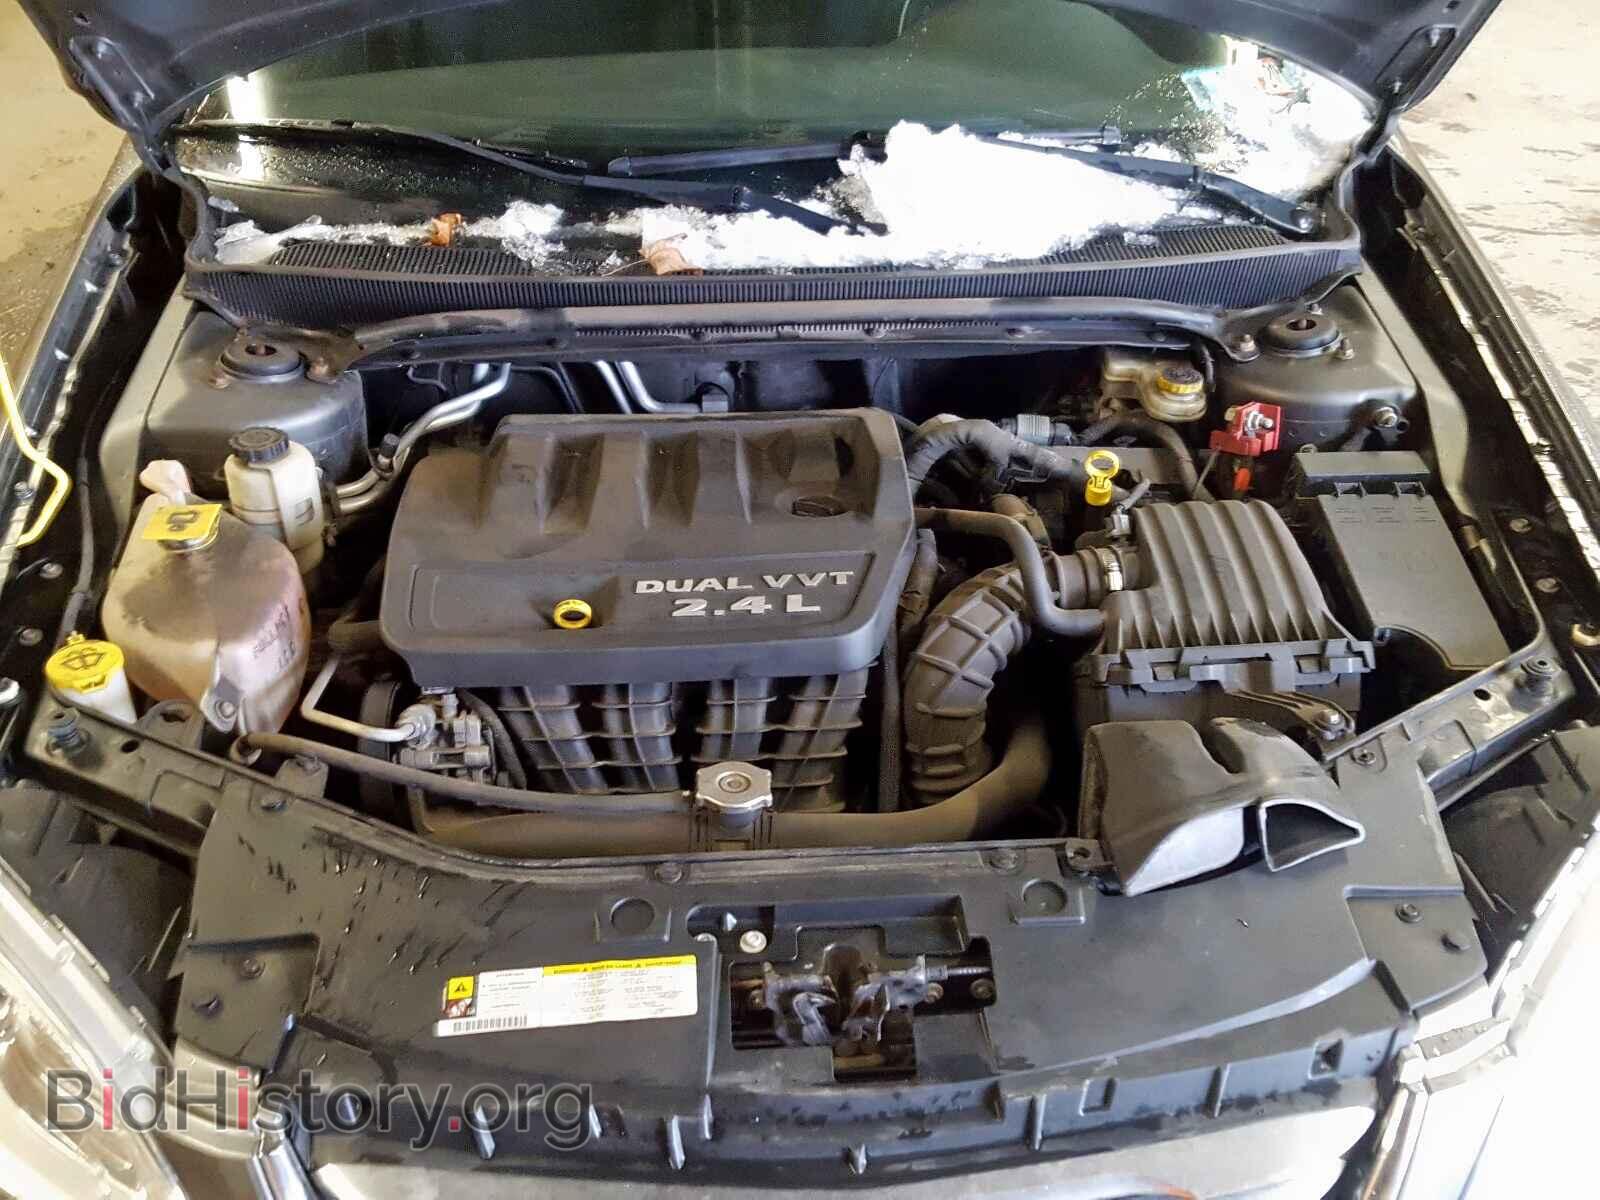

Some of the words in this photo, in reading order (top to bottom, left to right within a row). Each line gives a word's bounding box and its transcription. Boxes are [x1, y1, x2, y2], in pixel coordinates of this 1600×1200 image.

[634, 577, 752, 594] DUAL
[763, 571, 854, 589] VVT
[671, 595, 772, 617] 2.4
[786, 594, 821, 613] L
